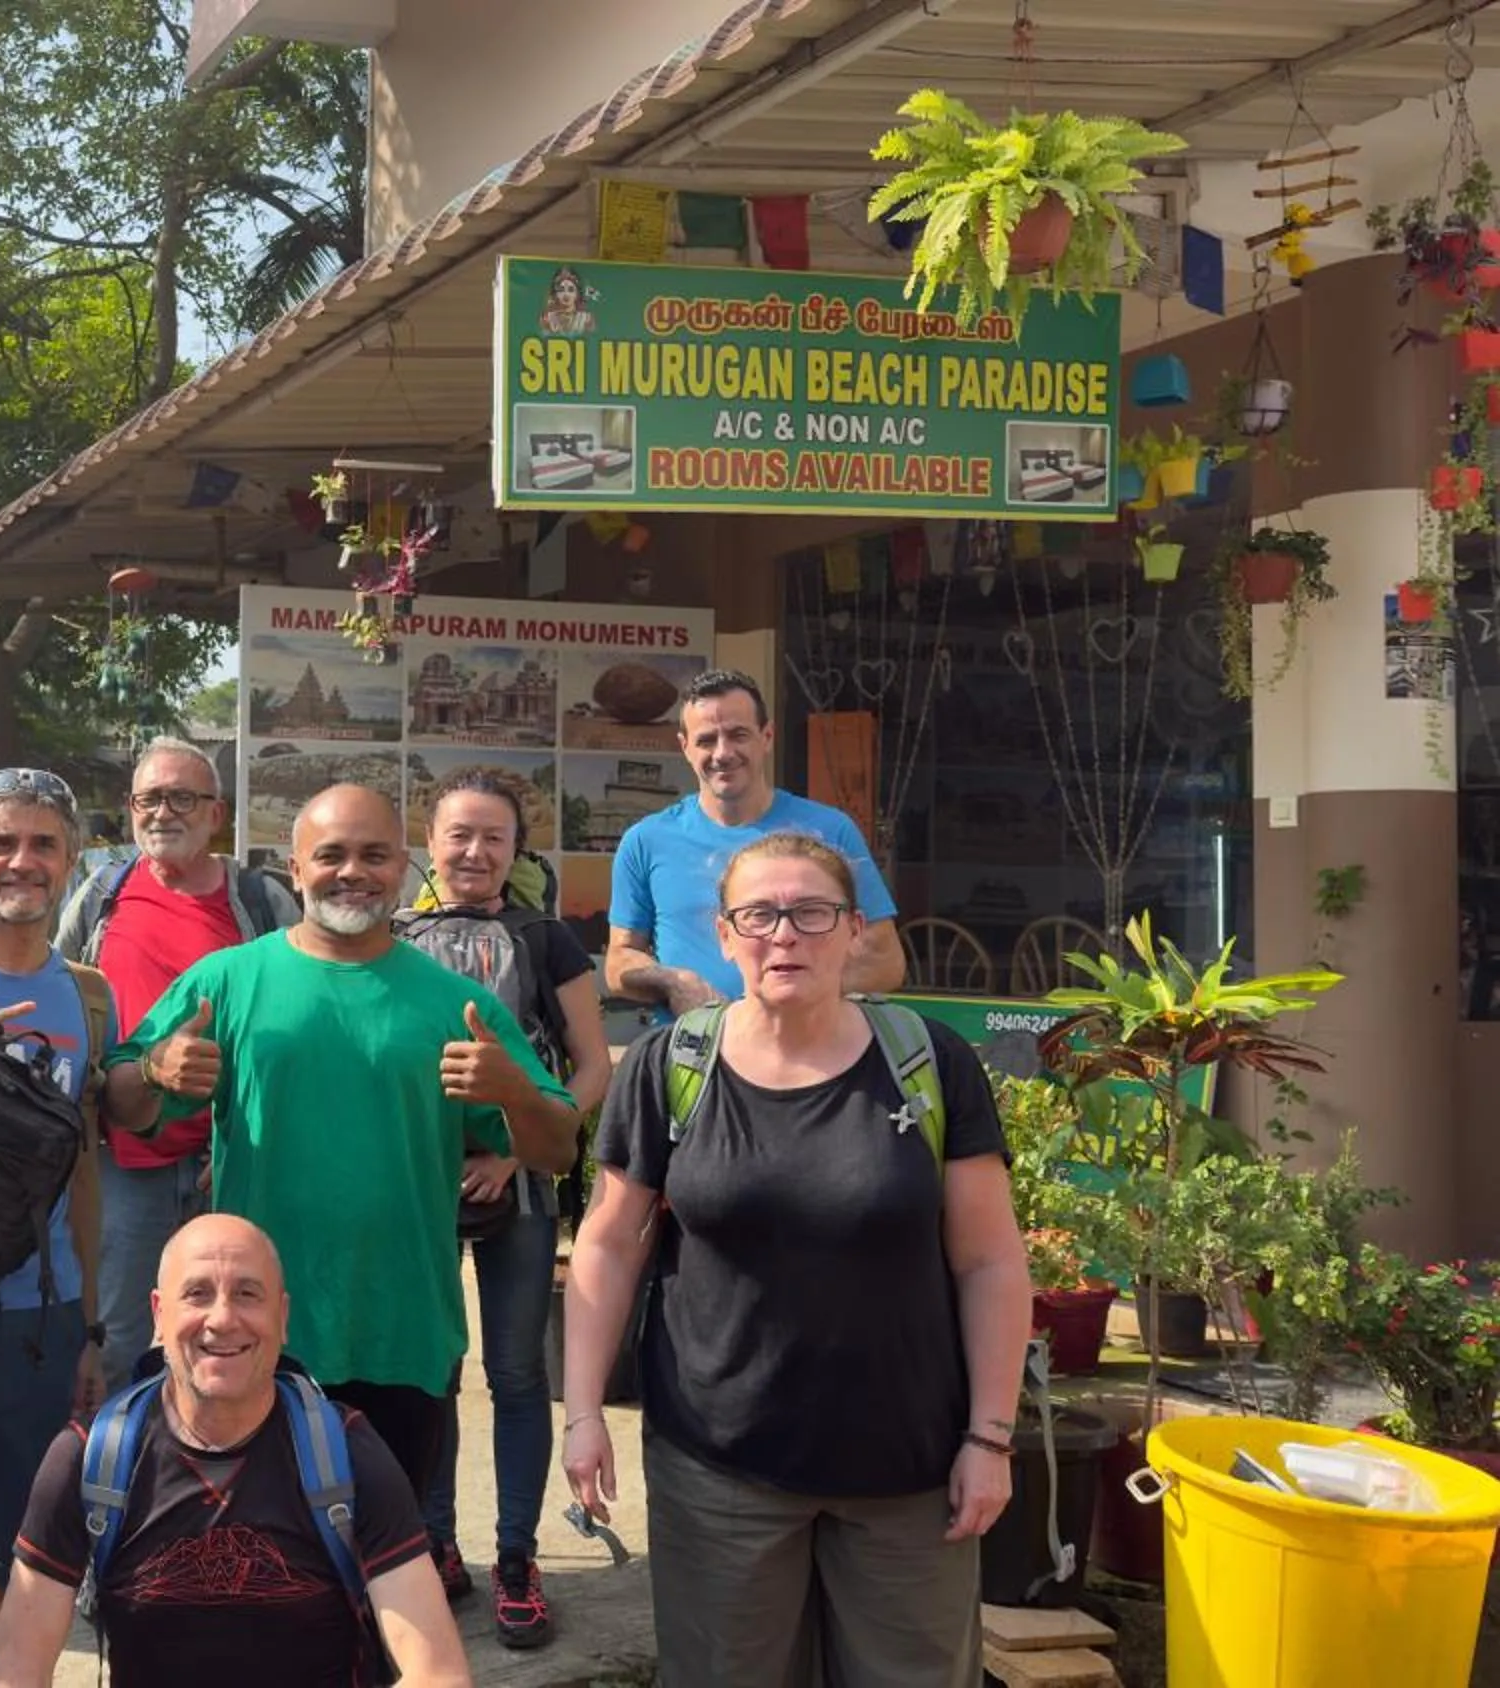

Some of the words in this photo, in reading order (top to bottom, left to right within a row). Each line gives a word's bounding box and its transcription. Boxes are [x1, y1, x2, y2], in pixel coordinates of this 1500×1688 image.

[645, 295, 793, 335] முருகன்
[800, 293, 849, 333] பீச்
[520, 338, 585, 394] SRI
[600, 342, 793, 400] MURUGAN
[807, 349, 927, 406] BEACH
[940, 356, 1108, 415] PARADISE
[714, 410, 762, 440] A/C
[774, 413, 795, 441] &
[807, 414, 870, 443] NON
[879, 416, 925, 445] A/C
[648, 448, 787, 491] ROOMS
[791, 452, 992, 496] AVAILABLE
[271, 607, 506, 640] MAMAPURAM
[516, 619, 690, 648] MONUMENTS
